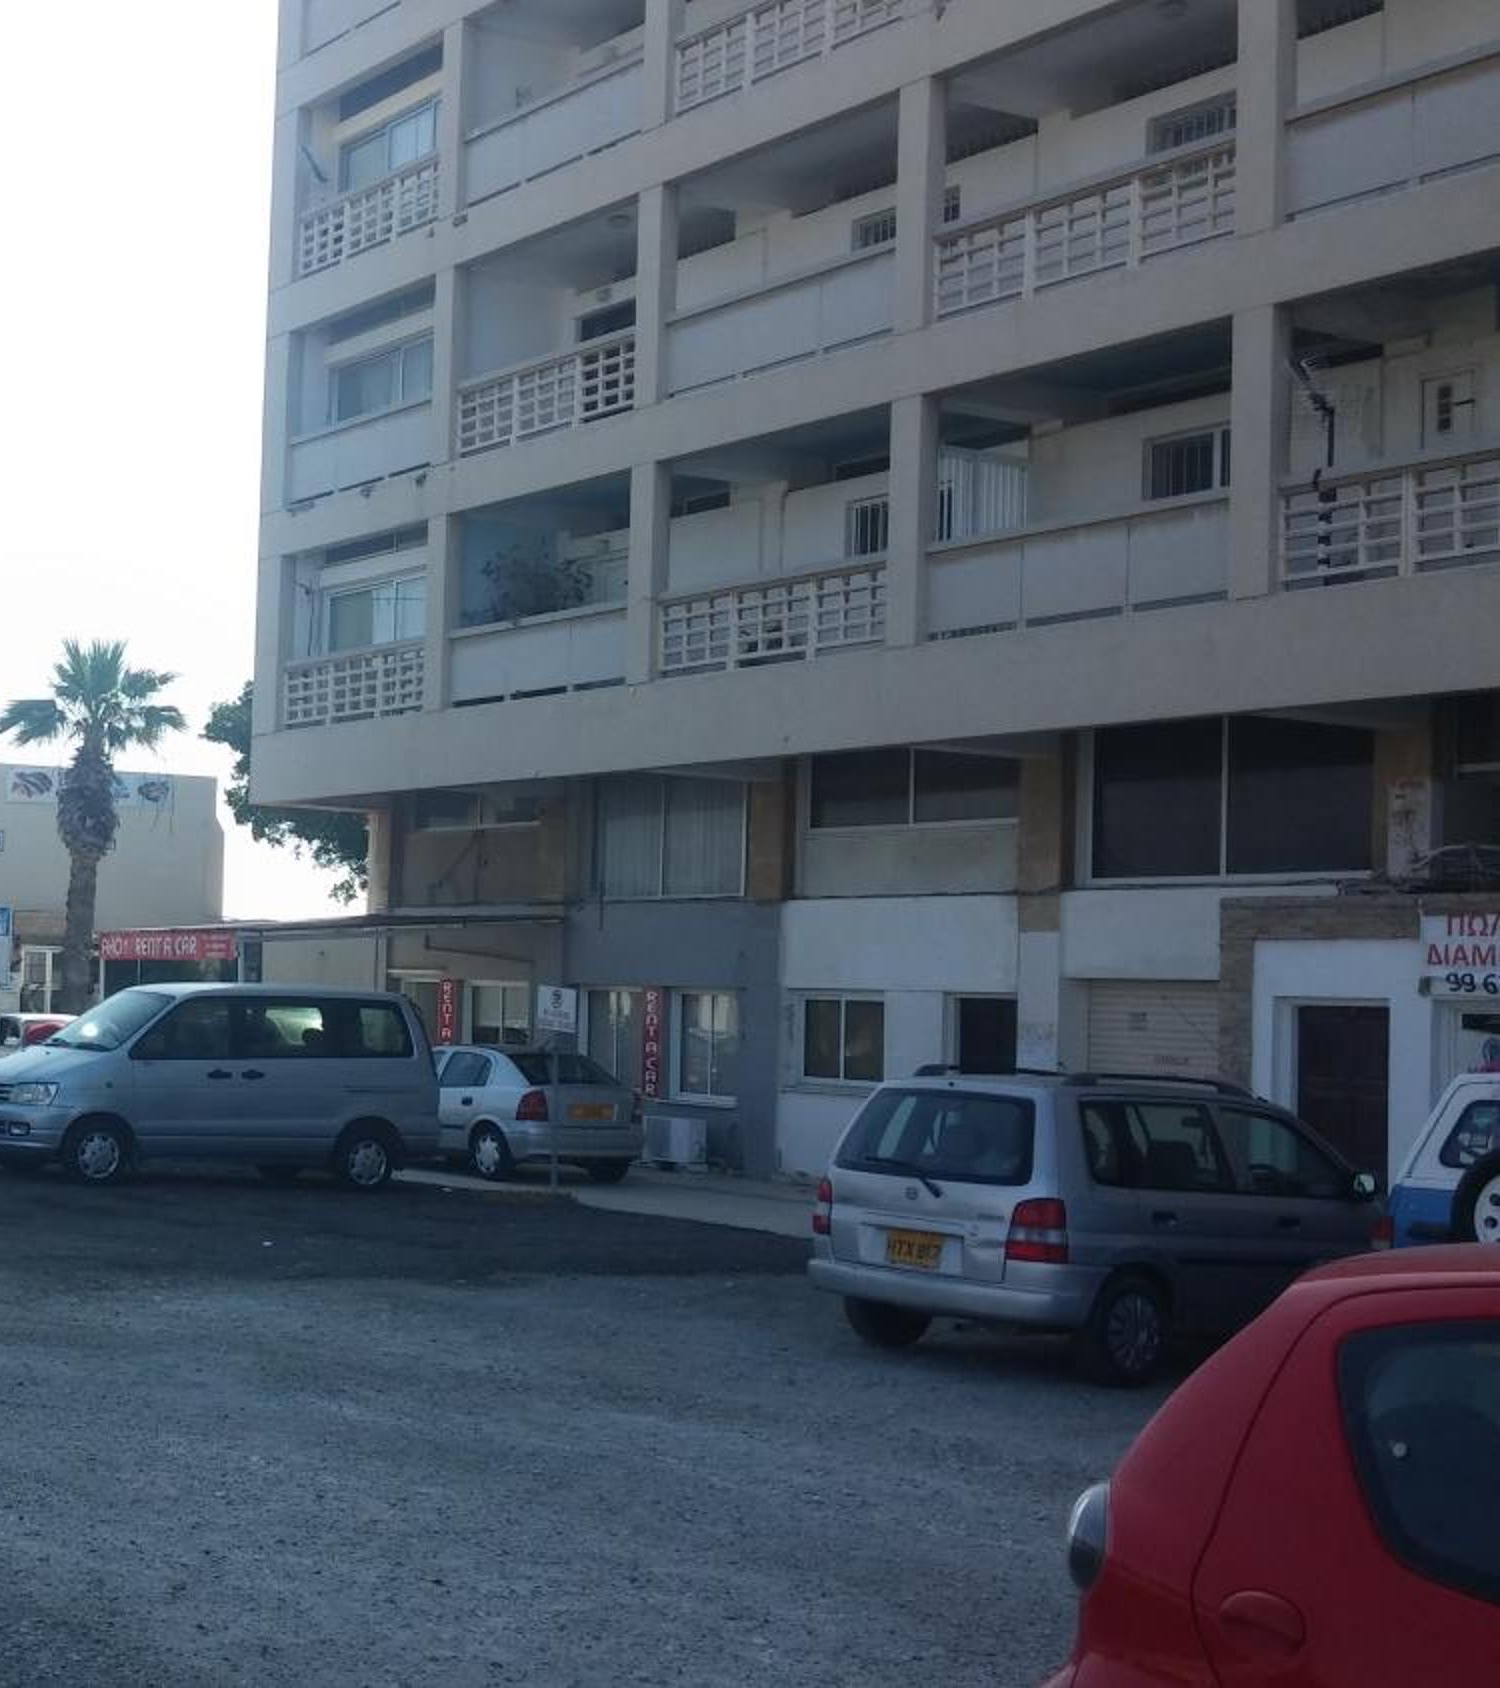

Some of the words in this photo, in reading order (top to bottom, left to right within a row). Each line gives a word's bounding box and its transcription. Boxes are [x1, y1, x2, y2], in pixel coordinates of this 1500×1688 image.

[135, 937, 162, 956] RENT
[163, 937, 174, 955] A
[175, 936, 197, 955] CAR
[1428, 944, 1500, 966] ΔΙΑΜ
[1482, 973, 1500, 994] 6
